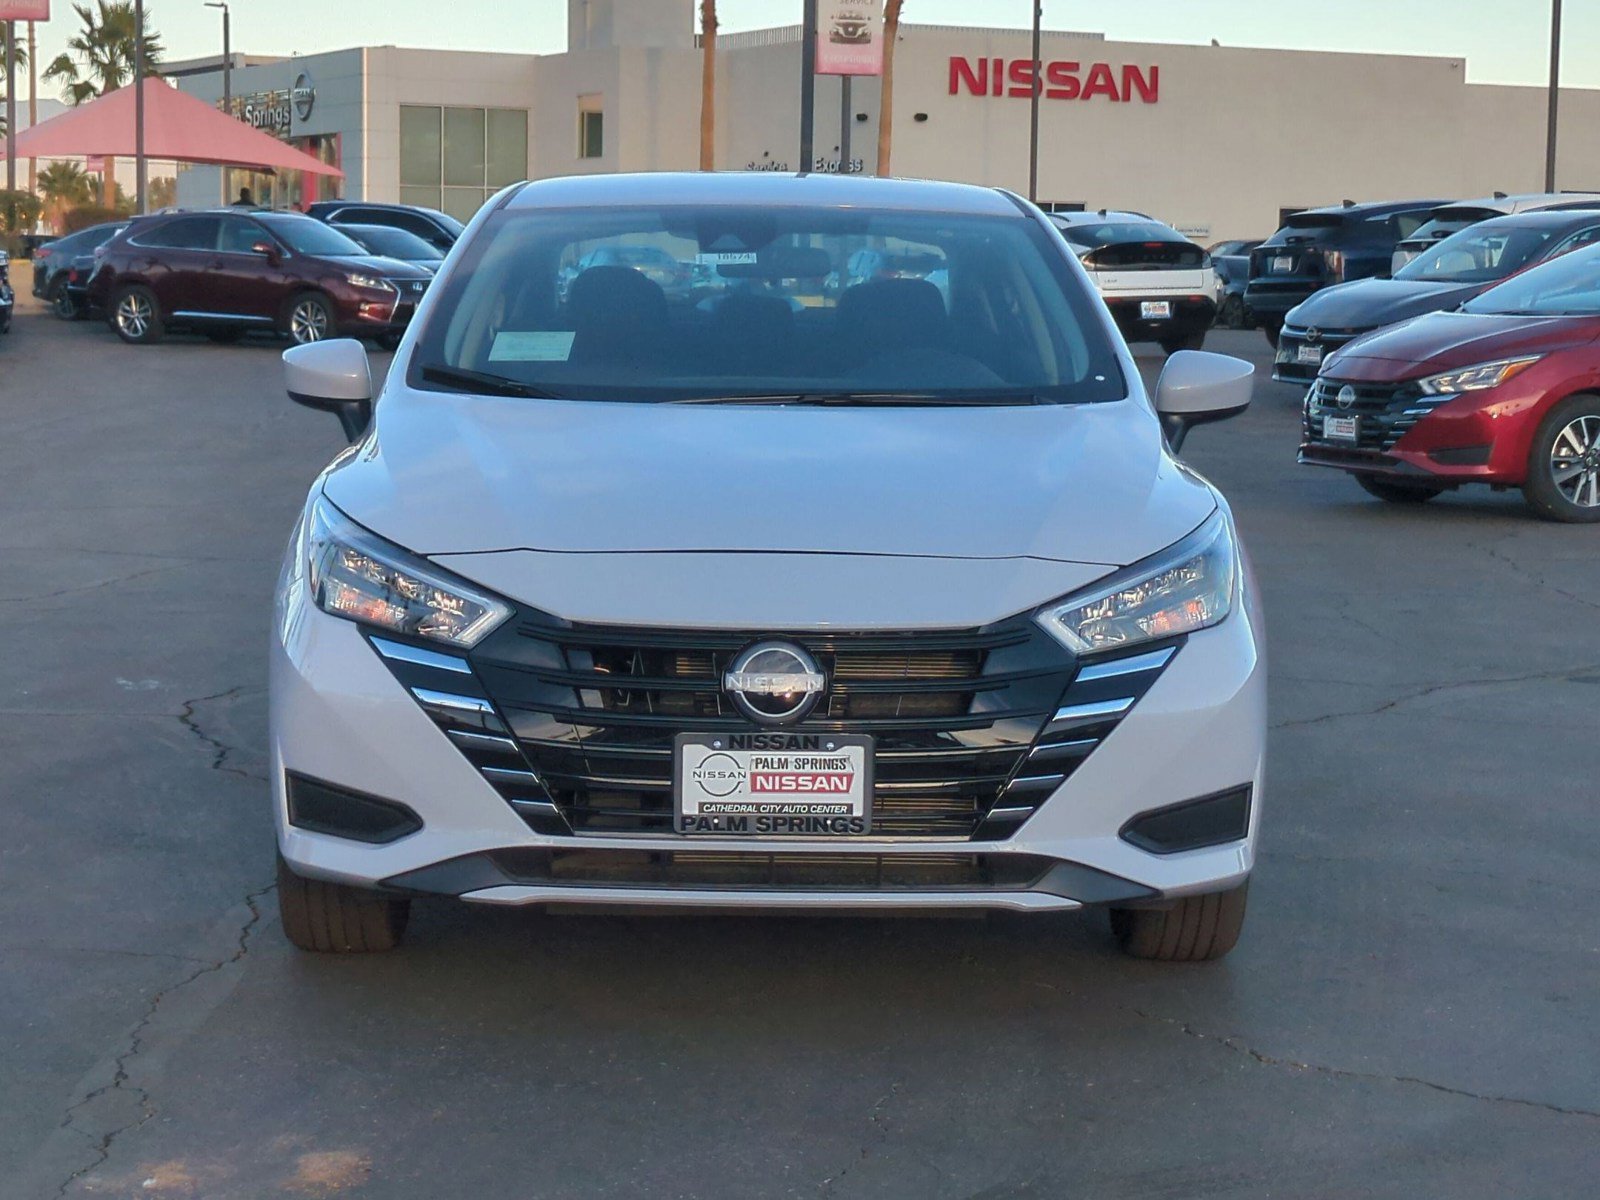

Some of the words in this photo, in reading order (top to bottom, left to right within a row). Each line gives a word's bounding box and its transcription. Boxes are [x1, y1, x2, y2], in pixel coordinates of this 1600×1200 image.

[948, 56, 1159, 104] NISSAN
[245, 104, 290, 130] Springs
[815, 159, 863, 172] Exprss
[729, 734, 820, 750] NISSAN
[755, 757, 789, 770] PALM
[794, 757, 847, 770] SPRINGS
[692, 771, 746, 779] NISSAN
[756, 775, 847, 791] NISSAN
[703, 804, 758, 814] CATHEDRAL
[760, 804, 780, 814] CITY
[782, 804, 808, 814] AUTO
[810, 804, 848, 814] CENTER
[681, 815, 748, 832] PALM
[756, 816, 865, 834] SPRINGS
